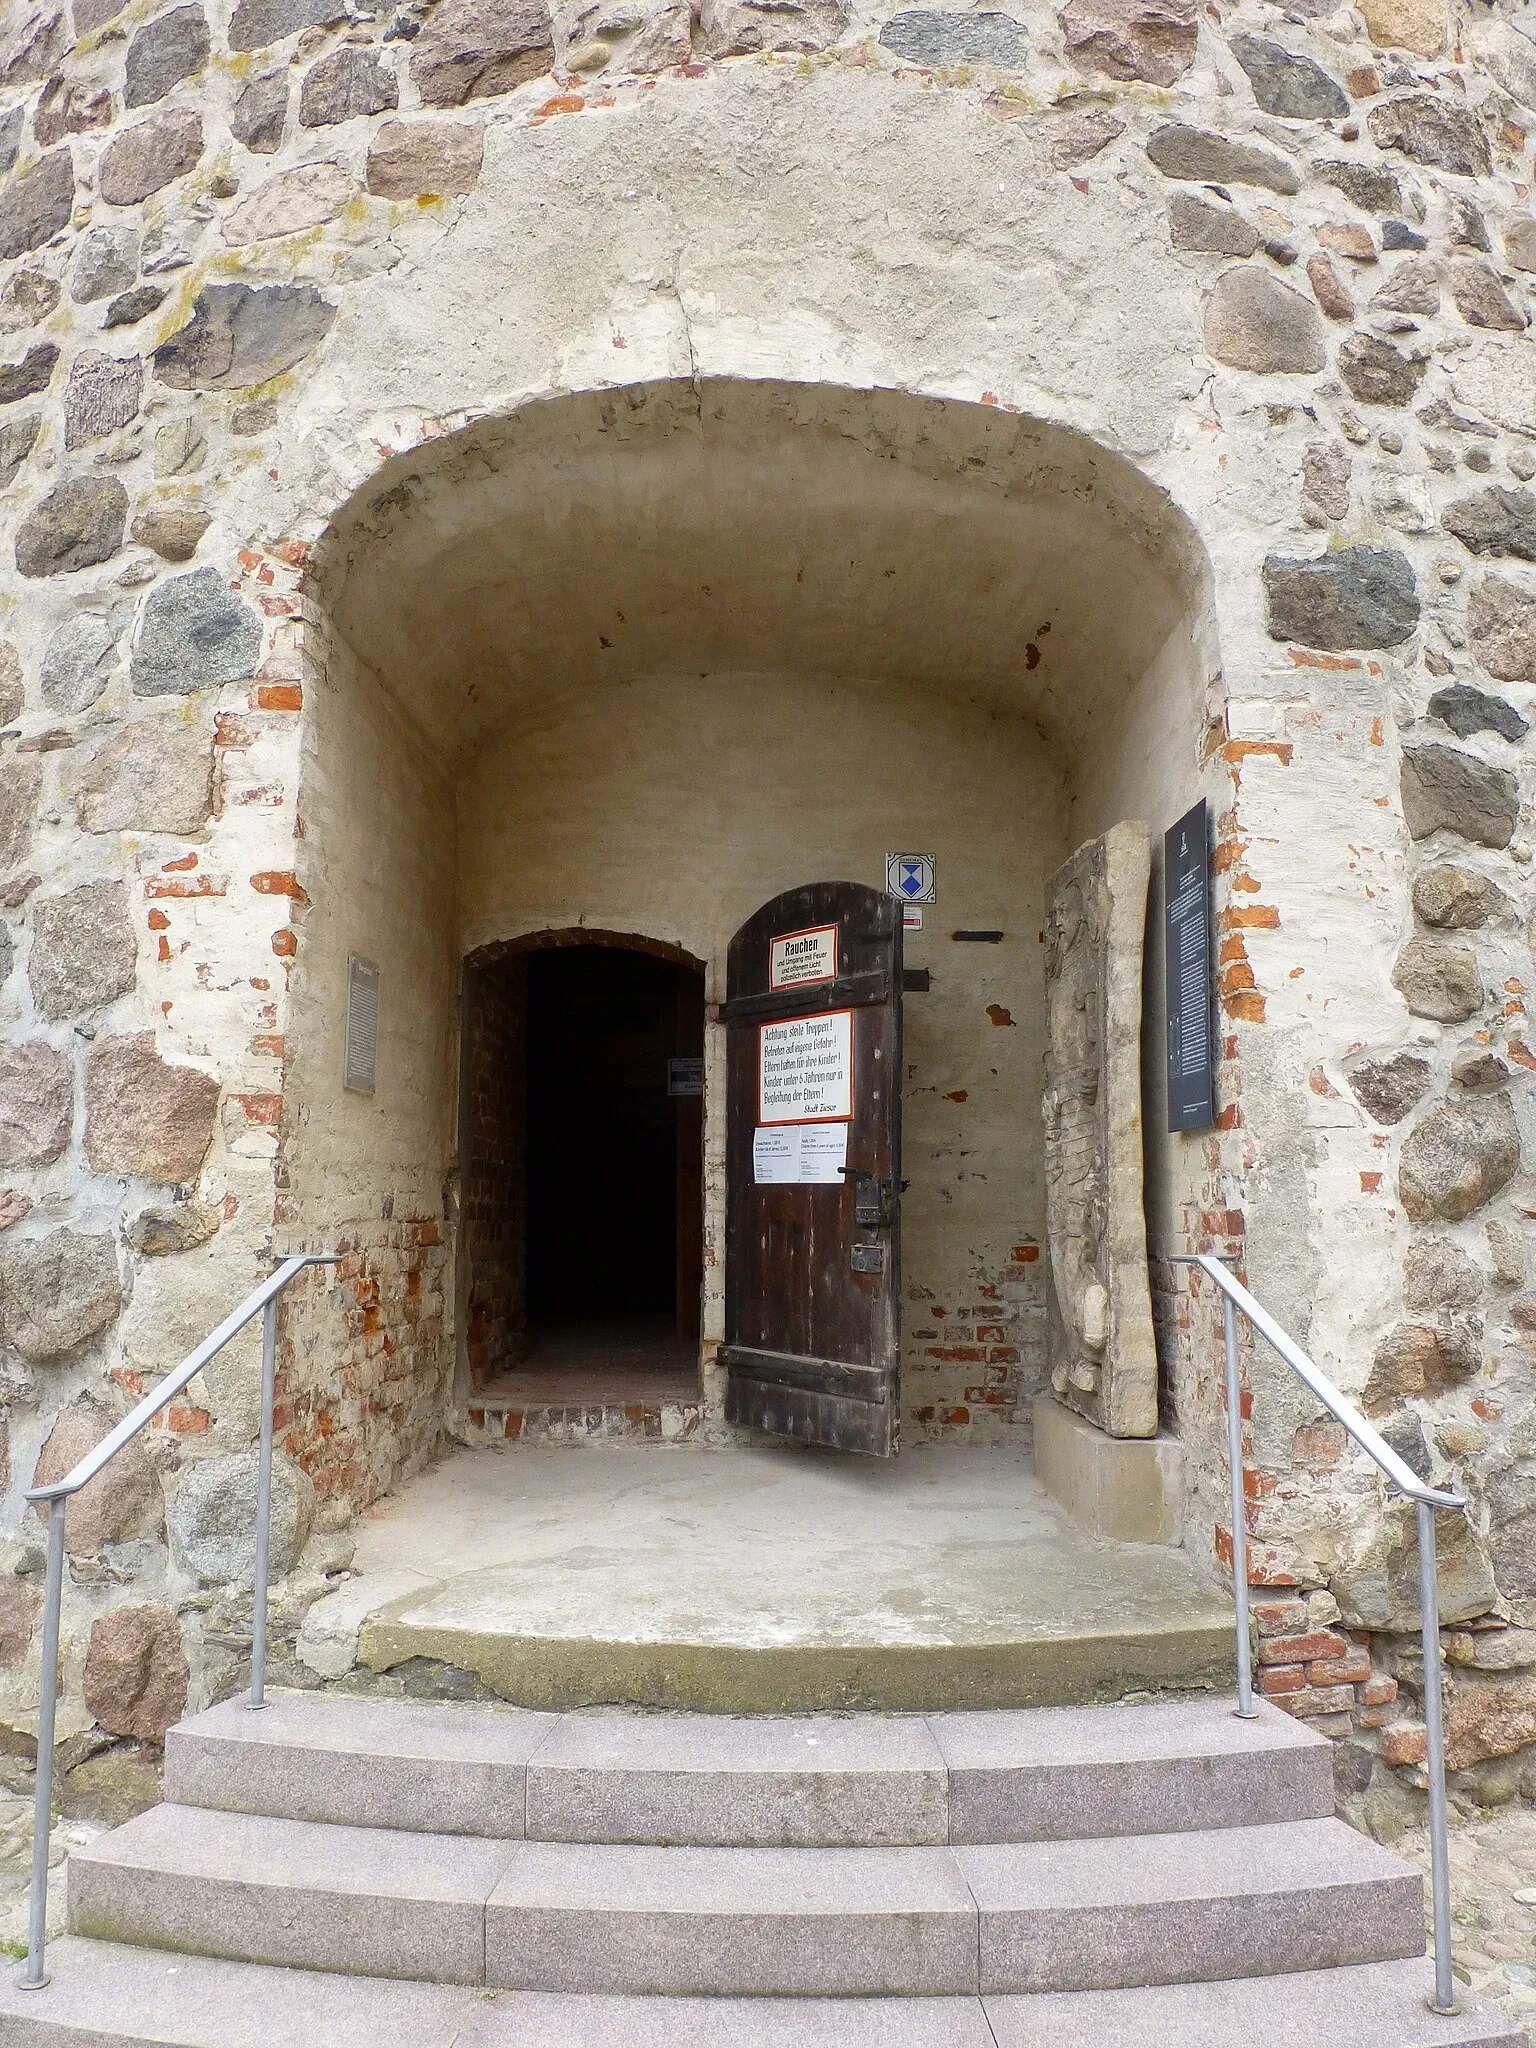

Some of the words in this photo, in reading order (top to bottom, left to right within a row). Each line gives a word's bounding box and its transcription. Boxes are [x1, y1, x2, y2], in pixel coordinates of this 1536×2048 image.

[785, 938, 818, 956] Rauchen
[786, 956, 804, 965] Umgang
[790, 964, 808, 972] offenem
[780, 972, 802, 982] polizeilich
[802, 969, 822, 978] verboten
[764, 1028, 788, 1040] Achtung
[789, 1024, 804, 1038] steile
[764, 1046, 785, 1058] Betreten
[786, 1042, 794, 1054] auf
[795, 1041, 812, 1054] eigene
[764, 1060, 780, 1072] Eltern
[796, 1057, 805, 1068] für
[806, 1056, 817, 1068] ihre
[764, 1076, 782, 1088] Kinder
[784, 1074, 798, 1086] unter
[799, 1074, 803, 1084] 6
[804, 1071, 826, 1083] Jahren
[826, 1071, 836, 1081] nur
[838, 1068, 843, 1080] in
[764, 1090, 792, 1106] Begleitung
[792, 1089, 802, 1101] der
[804, 1104, 818, 1113] Stadt
[820, 1103, 836, 1112] Ziesar
